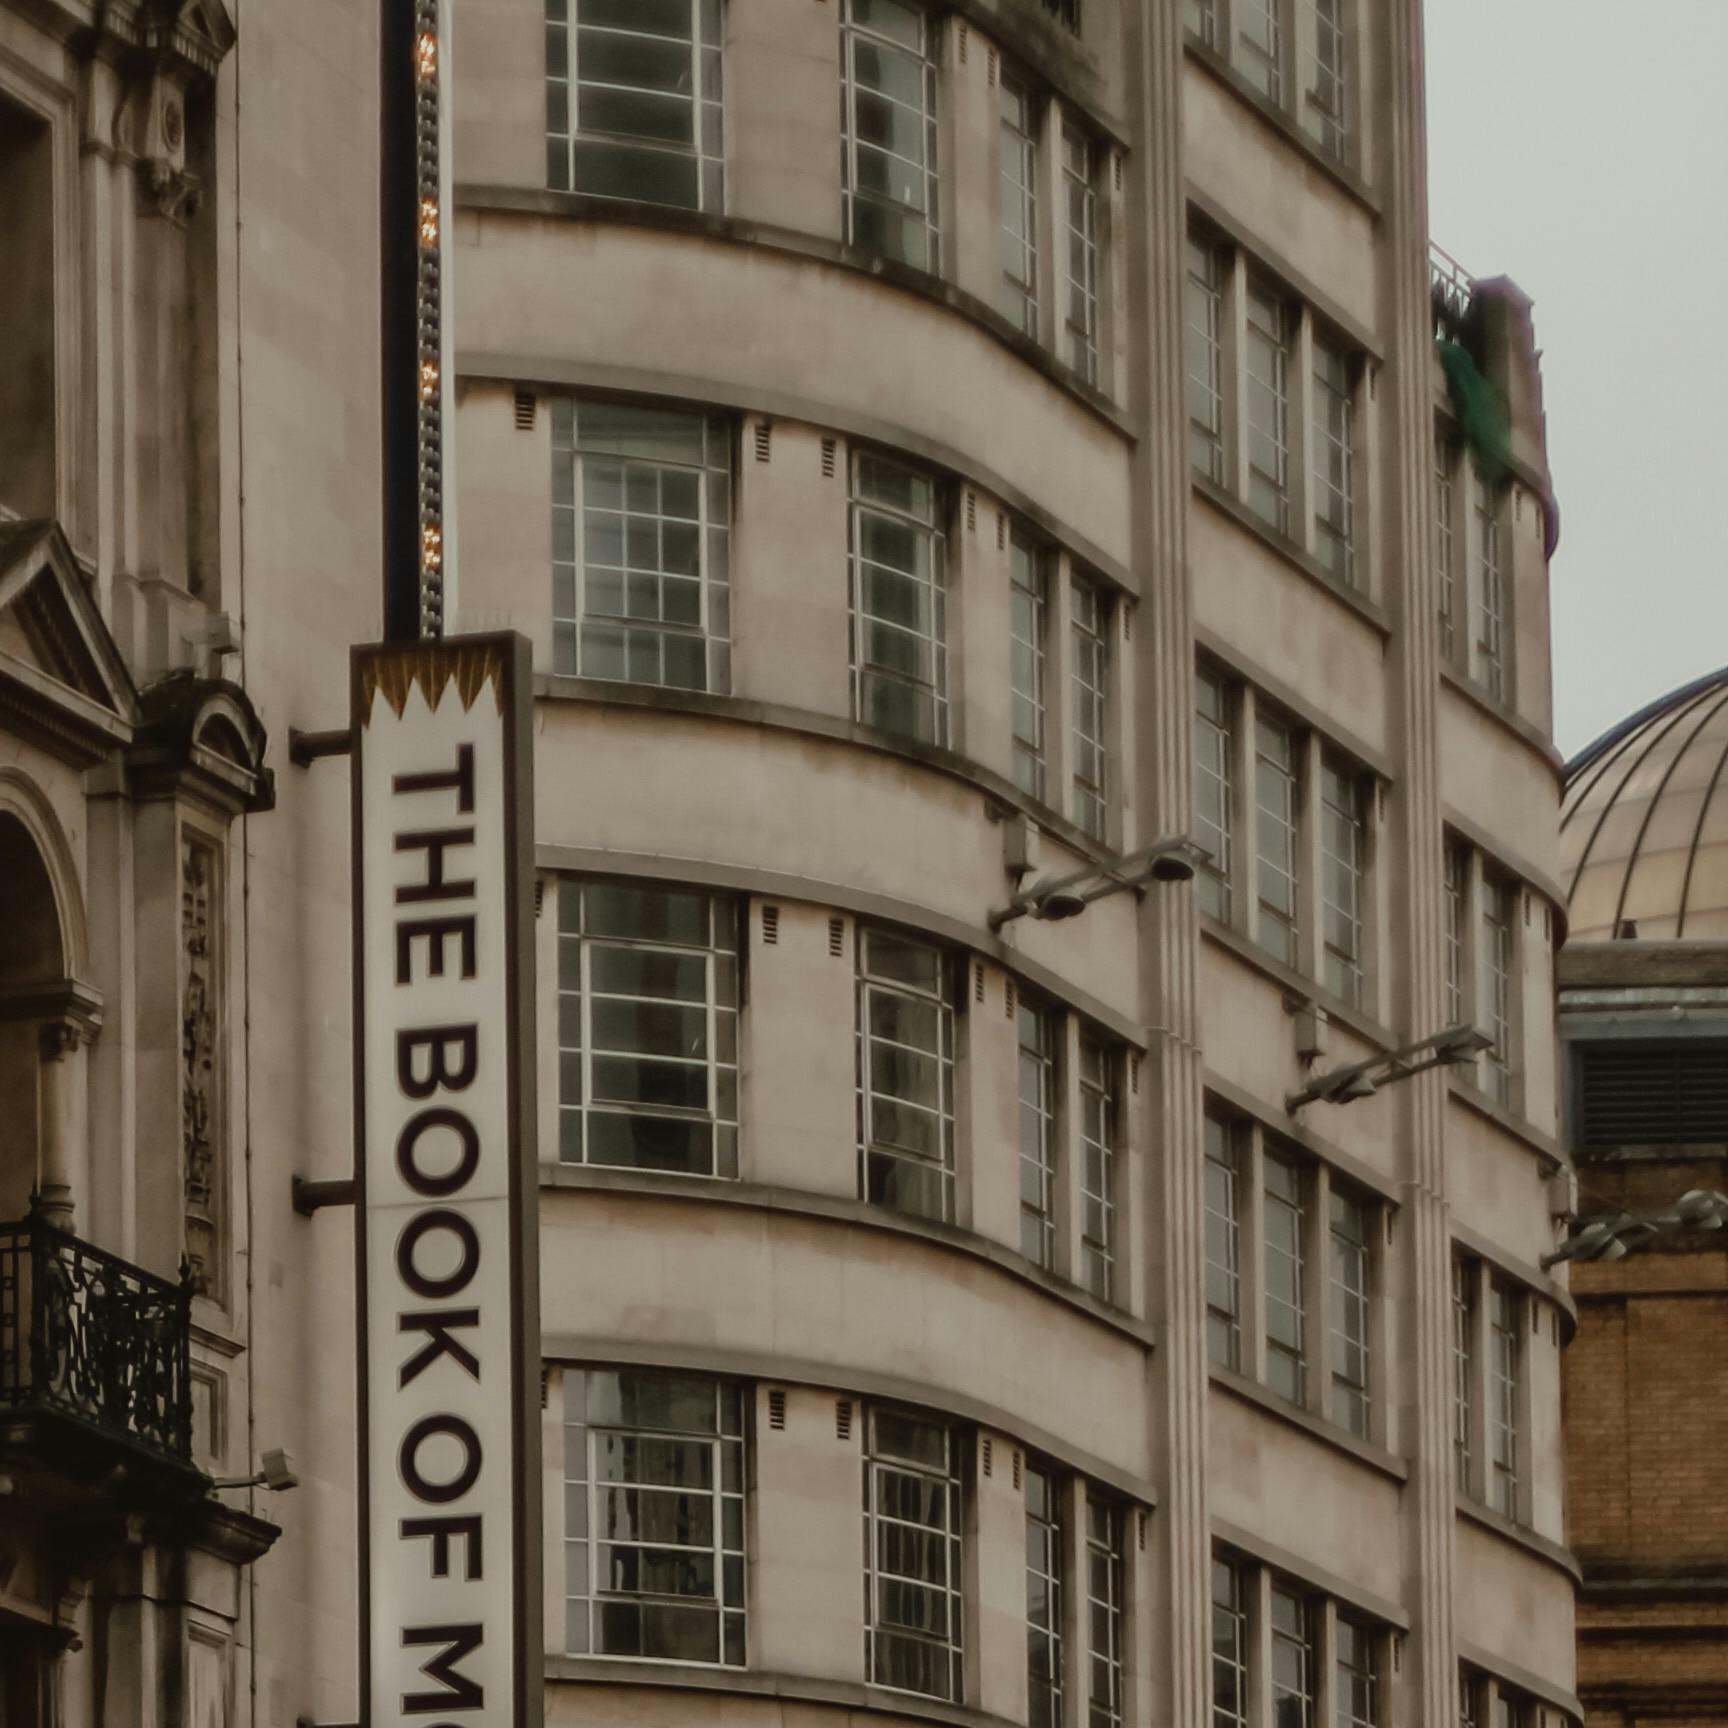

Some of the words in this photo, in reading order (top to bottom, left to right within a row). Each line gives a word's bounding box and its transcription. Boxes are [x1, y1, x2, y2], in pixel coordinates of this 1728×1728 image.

[391, 742, 476, 988] THE
[394, 1023, 482, 1395] BOOK
[395, 1411, 485, 1583] OF
